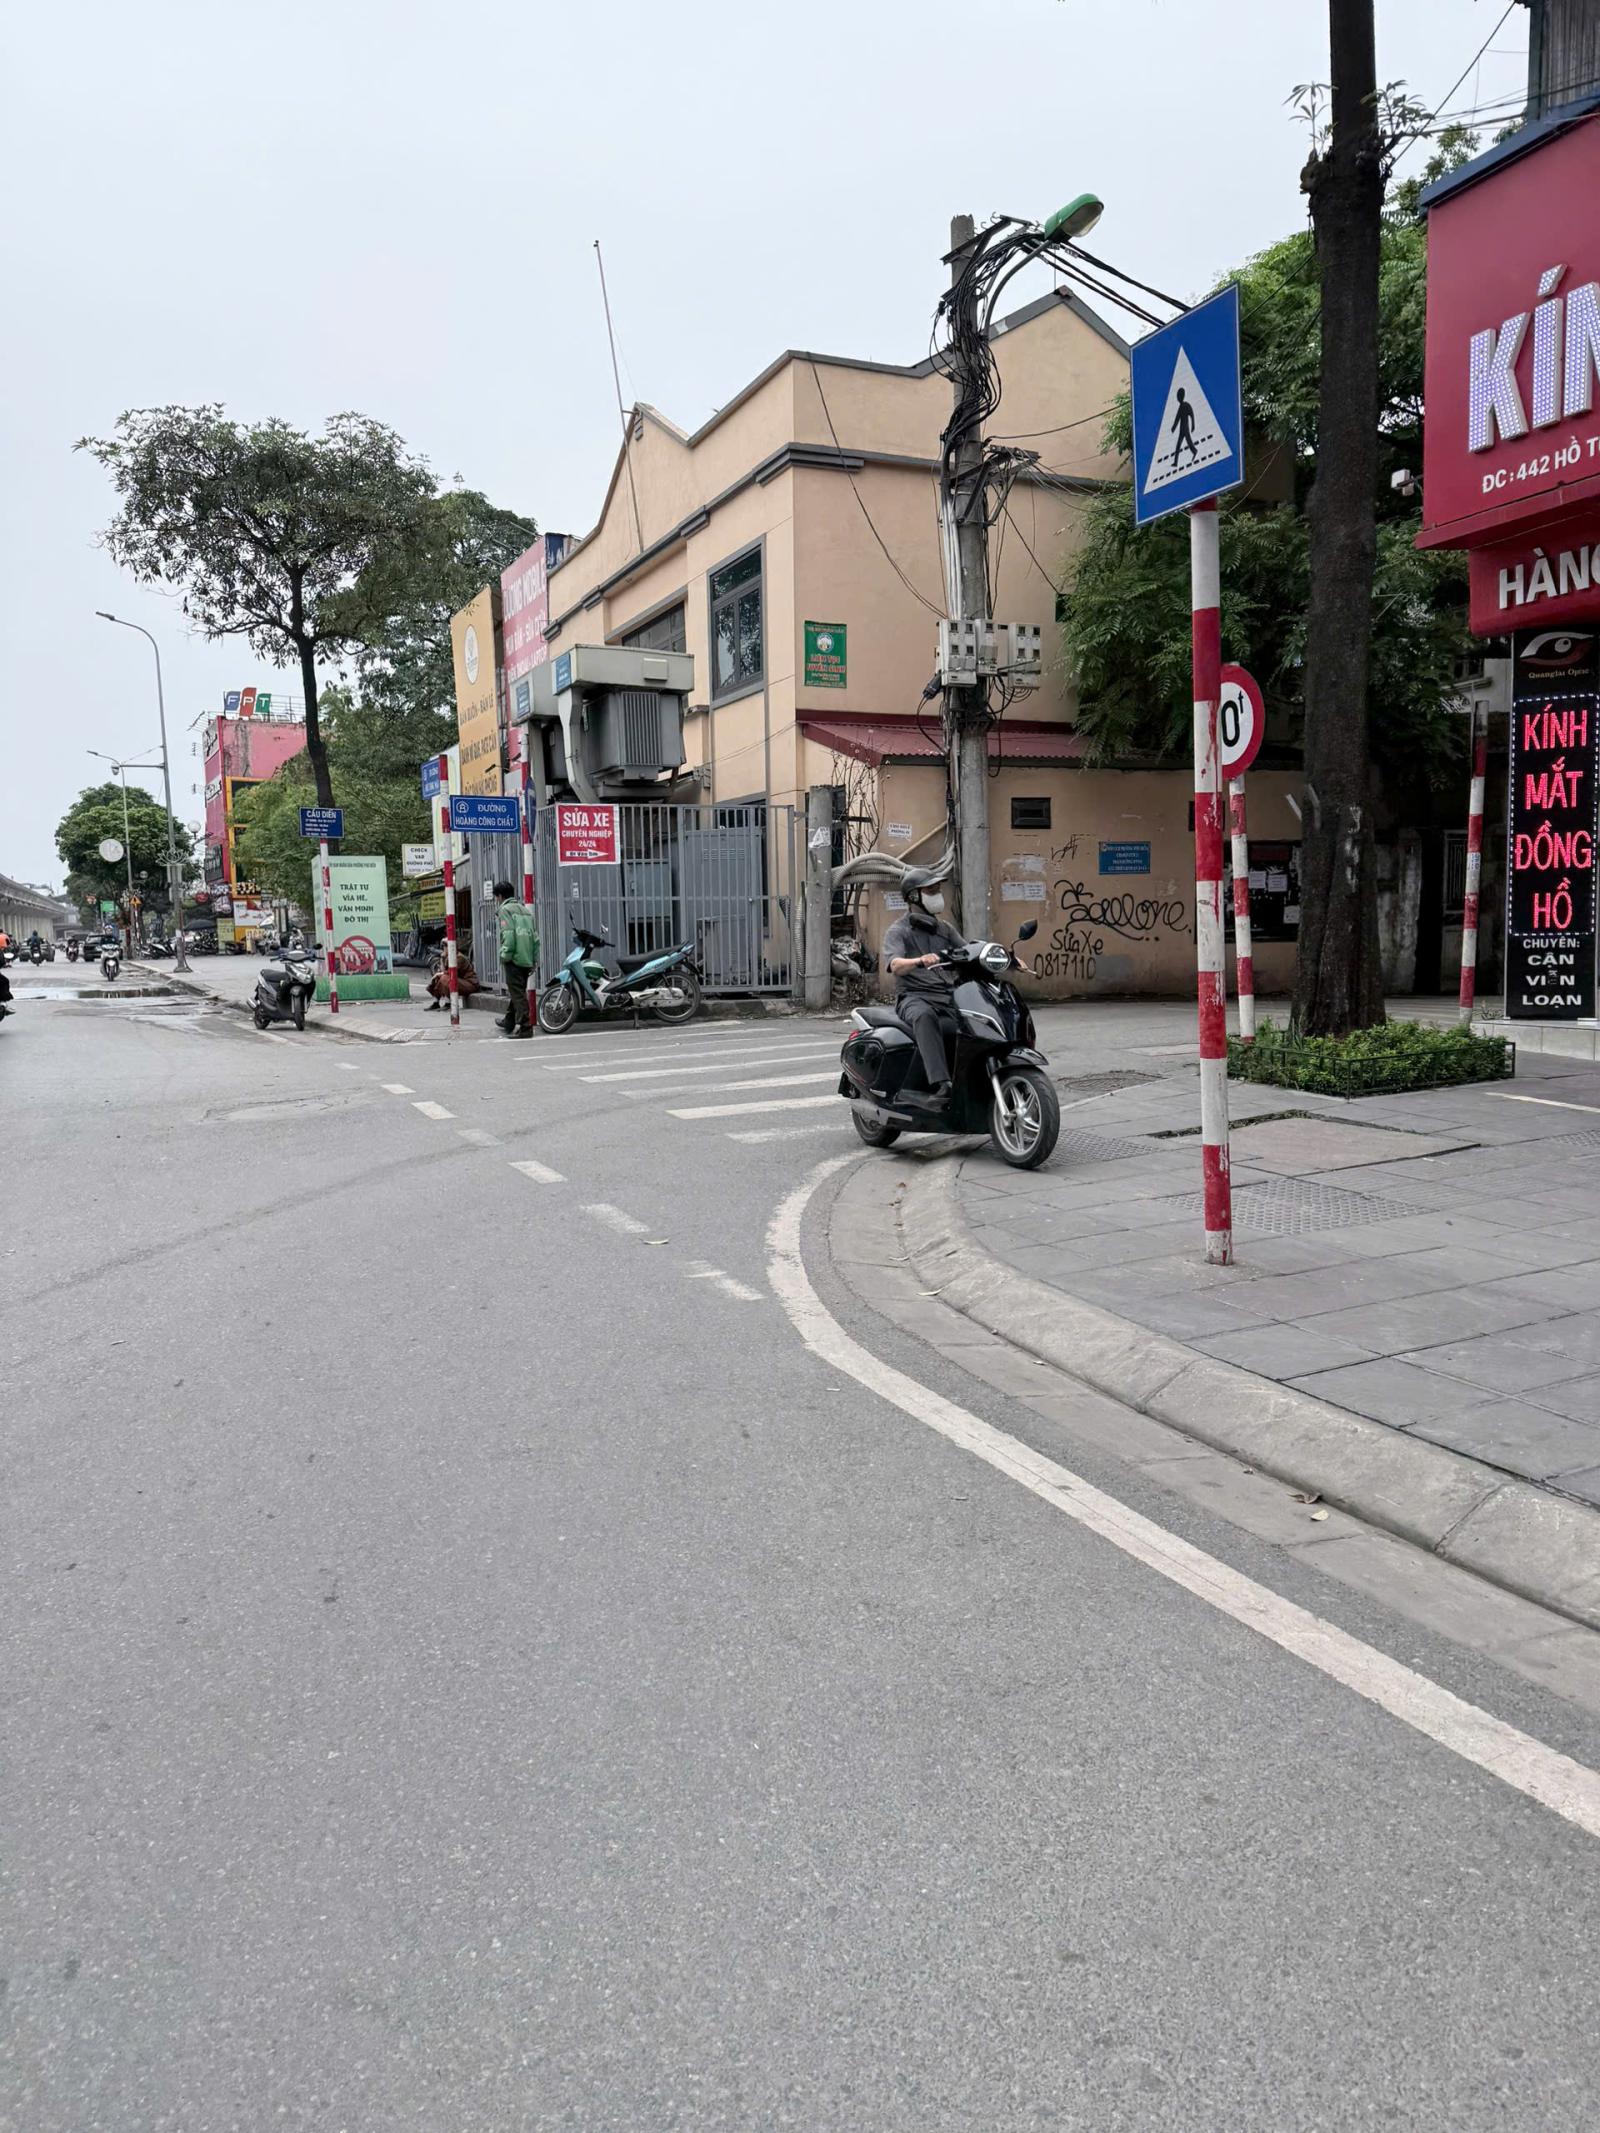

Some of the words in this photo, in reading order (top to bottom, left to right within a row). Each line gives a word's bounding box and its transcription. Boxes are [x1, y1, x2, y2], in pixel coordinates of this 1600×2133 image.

[1516, 455, 1550, 483] 442
[1554, 436, 1583, 470] HỒ
[1524, 703, 1588, 751] KÍNH
[1525, 756, 1583, 810] MẮT
[477, 803, 507, 813] ĐƯỜNG
[455, 815, 477, 826] HOÀNG
[478, 815, 496, 826] CÔNG
[497, 814, 514, 827] CHẤT
[563, 808, 590, 827] SỬA
[593, 812, 610, 827] XE
[561, 829, 588, 838] CHUYÊN
[588, 829, 612, 839] NGHIỆP
[1515, 819, 1592, 871] ĐỒNG
[1533, 877, 1573, 929] HỒ
[1523, 936, 1580, 949] CHUYÊN:
[1527, 951, 1575, 968] CẬN
[1522, 994, 1582, 1009] LOẠN
